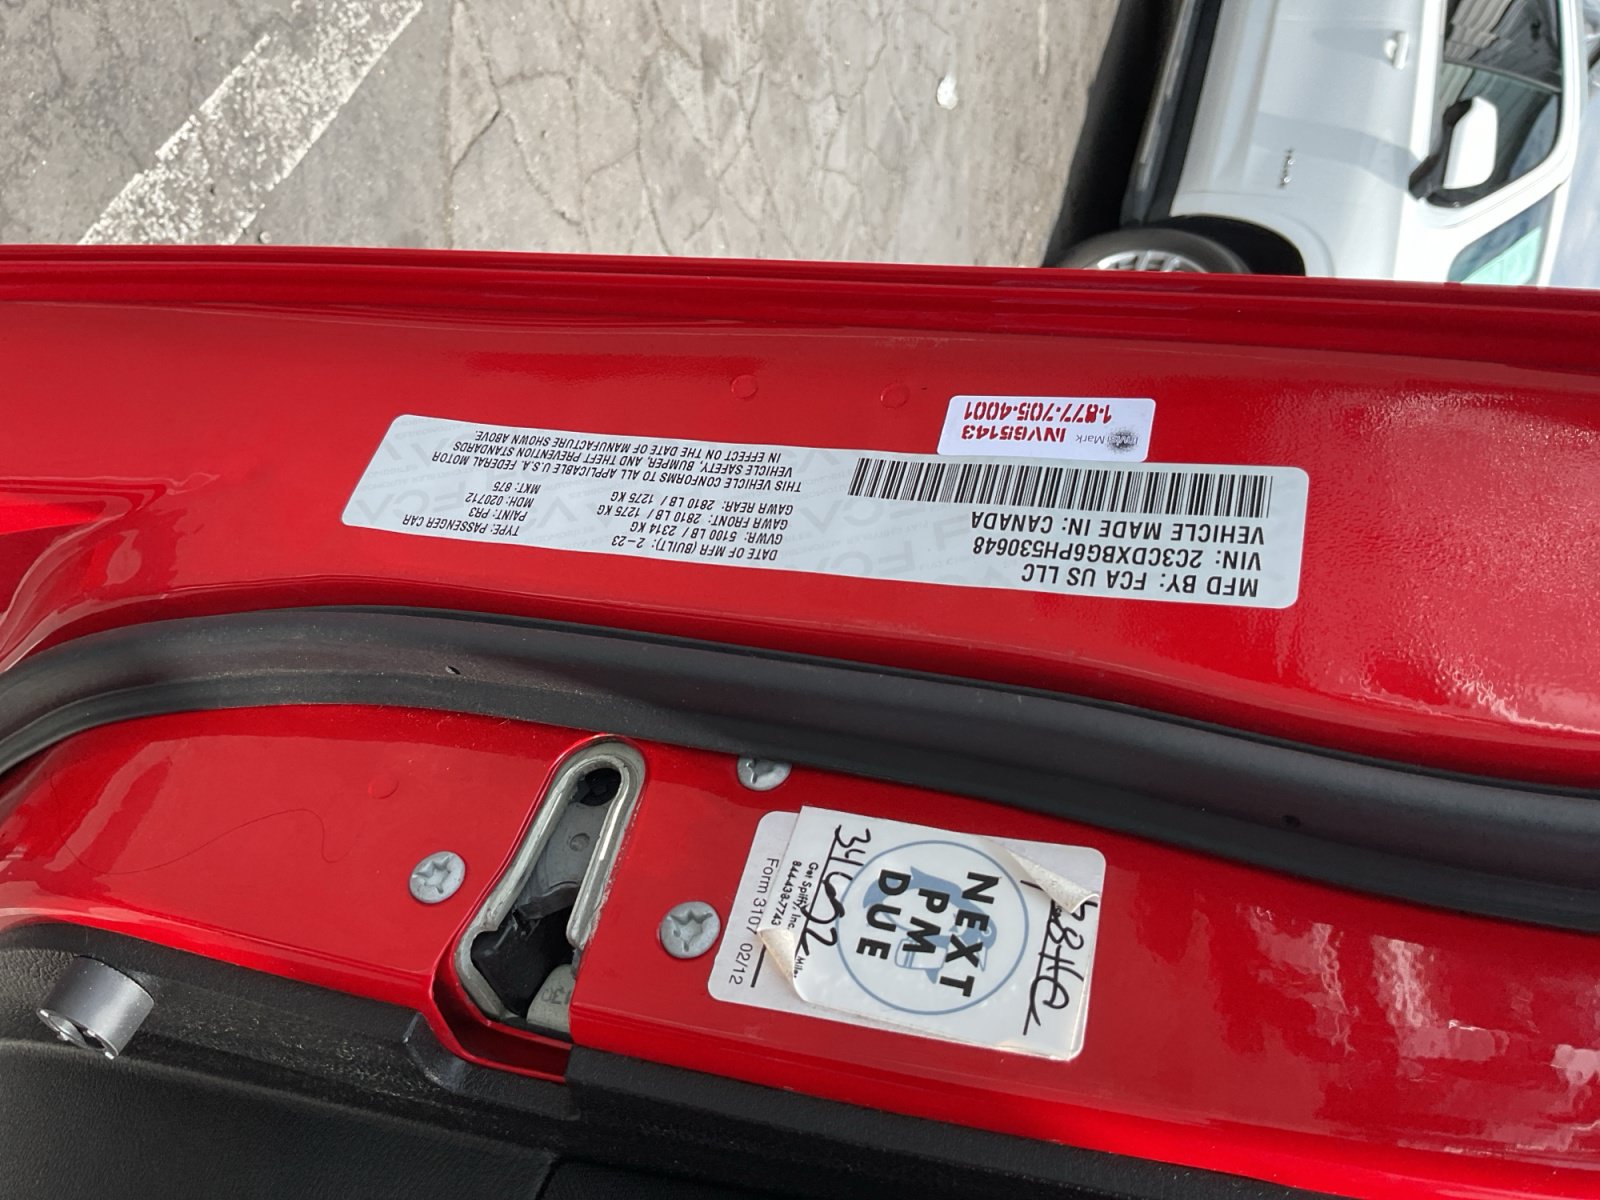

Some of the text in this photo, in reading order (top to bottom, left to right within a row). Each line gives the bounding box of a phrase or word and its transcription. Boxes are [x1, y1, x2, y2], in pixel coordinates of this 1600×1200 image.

[475, 431, 510, 444] ABOVE.
[510, 434, 551, 447] SHOWN
[1075, 434, 1105, 445] Mark
[552, 437, 632, 453] MANUFACTURE
[632, 444, 648, 454] OF
[650, 445, 678, 456] DATE
[453, 441, 792, 478] VEHICLE SAFETY, BUMPER, AND THEFT PREVENTION STANDARDS
[680, 447, 702, 459] THE
[705, 449, 722, 460] ON
[724, 450, 765, 462] EFFECT
[768, 452, 782, 463] IN
[432, 451, 802, 492] THIS VEHICLE CONFORMS TO ALL APPLICABLE U.S.A. FEDERAL MOTOR
[492, 481, 541, 494] MKT: 875
[465, 492, 534, 508] MDH: 020712
[610, 491, 627, 502] KG
[628, 492, 654, 504] 1275
[596, 504, 613, 516] KG
[687, 498, 715, 510] 2810
[722, 501, 756, 514] REAR:
[758, 503, 794, 516] GAWR
[468, 507, 528, 522] PAINT: PR3
[614, 506, 640, 518] 1275
[673, 511, 702, 524] 2810
[402, 514, 520, 536] TYPE: PASSENGER CAR
[630, 521, 646, 533] KG
[708, 514, 750, 528] FRONT:
[752, 517, 788, 530] GAWR
[649, 523, 677, 536] 2314
[972, 511, 1264, 545] VEHICLE MADE IN: CANADA
[709, 529, 738, 542] 5100
[744, 532, 783, 545] GVWR:
[652, 538, 697, 554] (BUILT):
[699, 544, 726, 557] MFR
[728, 547, 745, 558] OF
[747, 548, 778, 561] DATE
[973, 536, 1261, 571] VIN: 2C3CDXBG6PH530648
[1021, 563, 1258, 598] MFD BY: FCA US LLC
[805, 862, 819, 879] Get
[771, 860, 802, 926] 844-438-7743
[728, 857, 779, 985] Form 3107 02/12
[855, 869, 912, 961] DUE
[902, 887, 951, 954] PM
[786, 913, 801, 931] Inc.
[939, 871, 1000, 998] NEXT
